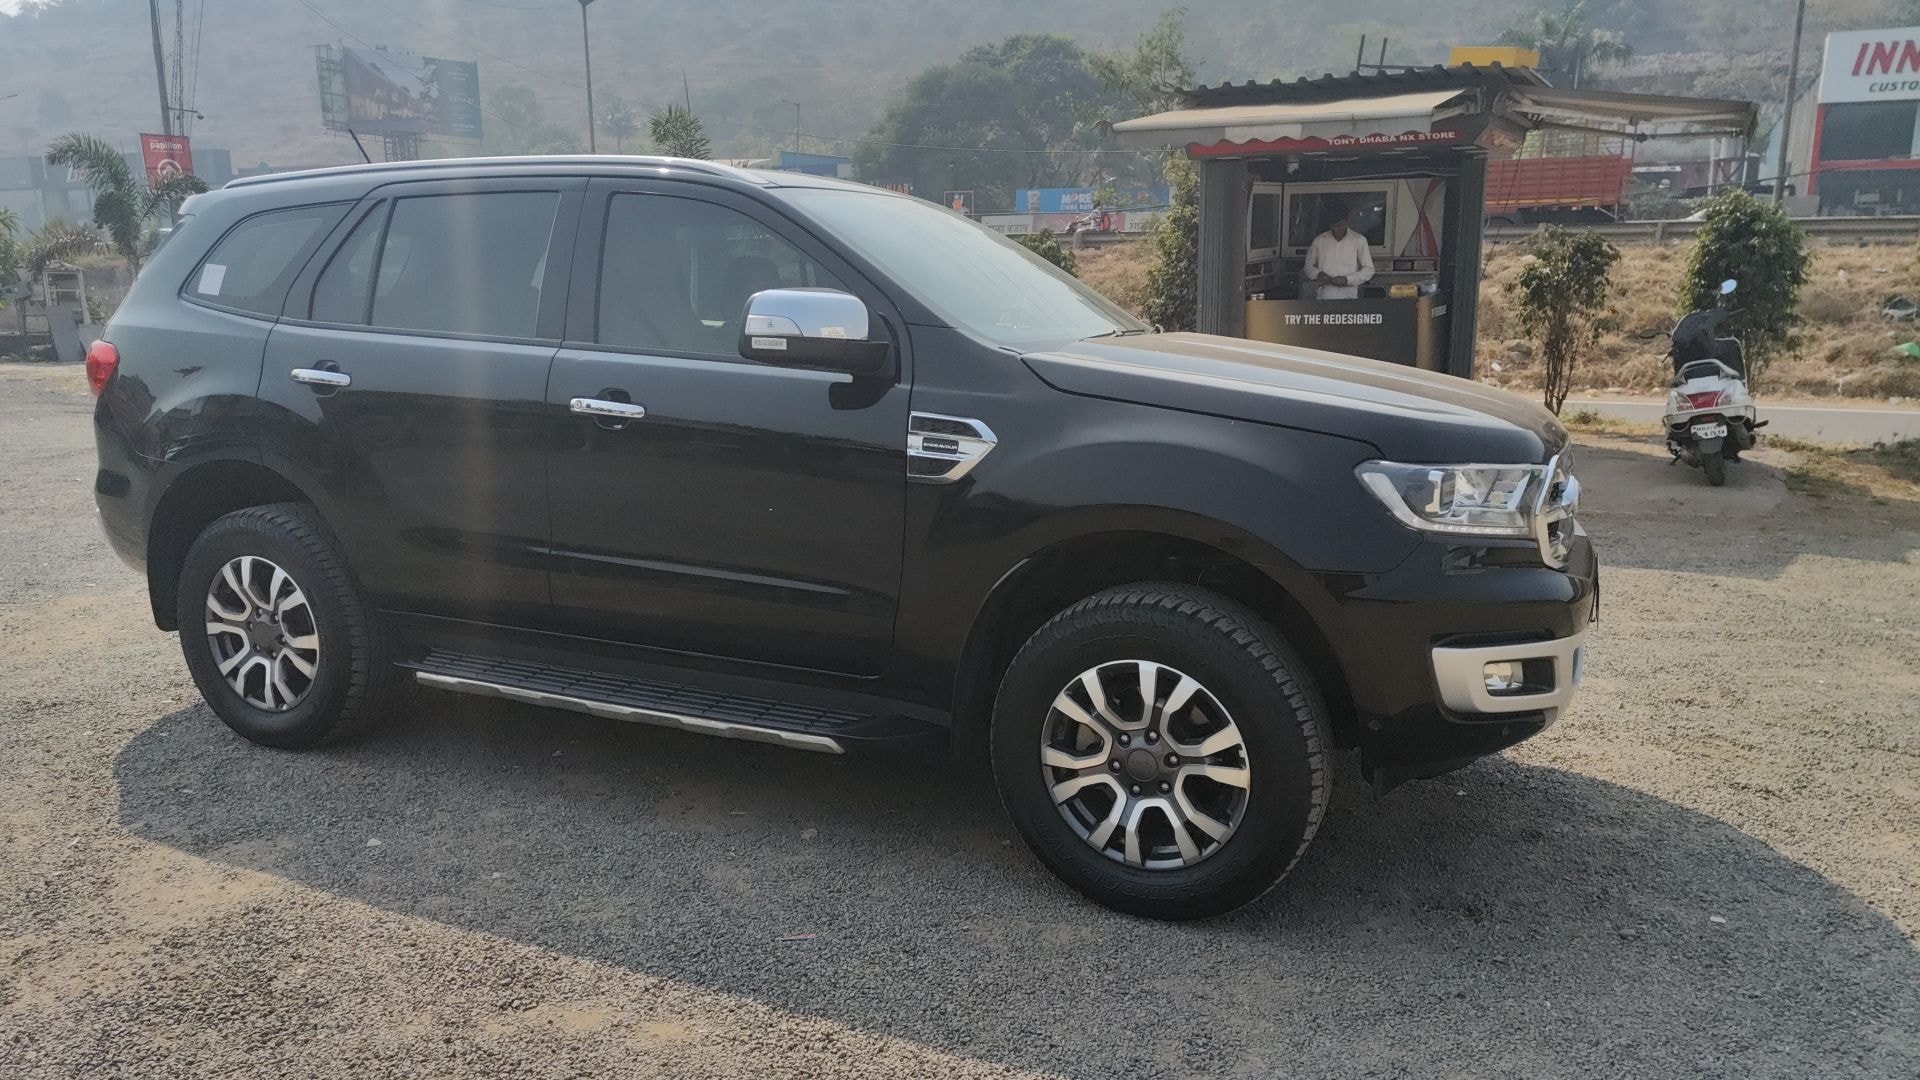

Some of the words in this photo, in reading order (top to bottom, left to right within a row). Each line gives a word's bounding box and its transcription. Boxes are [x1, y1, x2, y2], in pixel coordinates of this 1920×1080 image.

[1360, 136, 1397, 144] DHABA
[1418, 131, 1455, 140] STORE
[1284, 314, 1301, 325] TRY
[1304, 314, 1321, 325] THE
[1323, 313, 1383, 325] REDESIGNED
